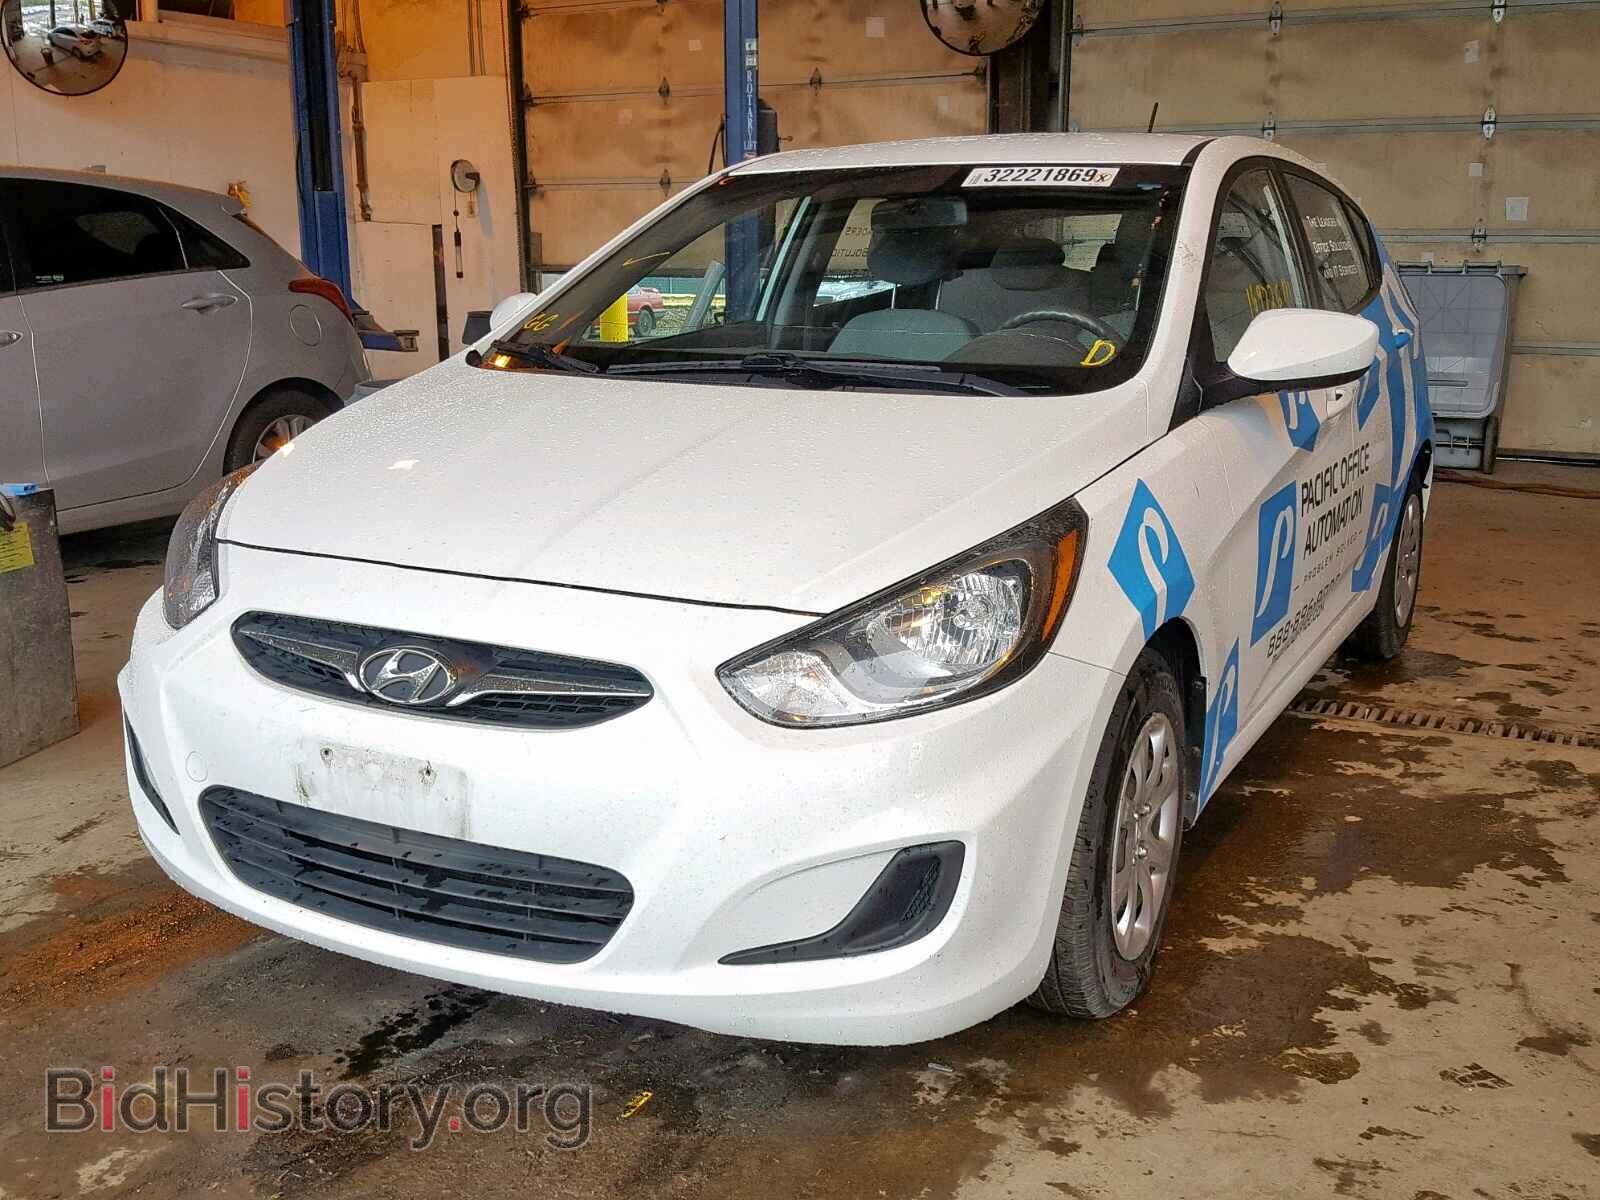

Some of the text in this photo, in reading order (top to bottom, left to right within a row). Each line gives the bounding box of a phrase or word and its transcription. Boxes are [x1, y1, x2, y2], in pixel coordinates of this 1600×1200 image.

[746, 70, 754, 141] ROTARY
[984, 168, 1098, 183] 32221869
[1301, 443, 1369, 517] PACIFIC OFFICE
[1302, 485, 1365, 561] AUTOMATION
